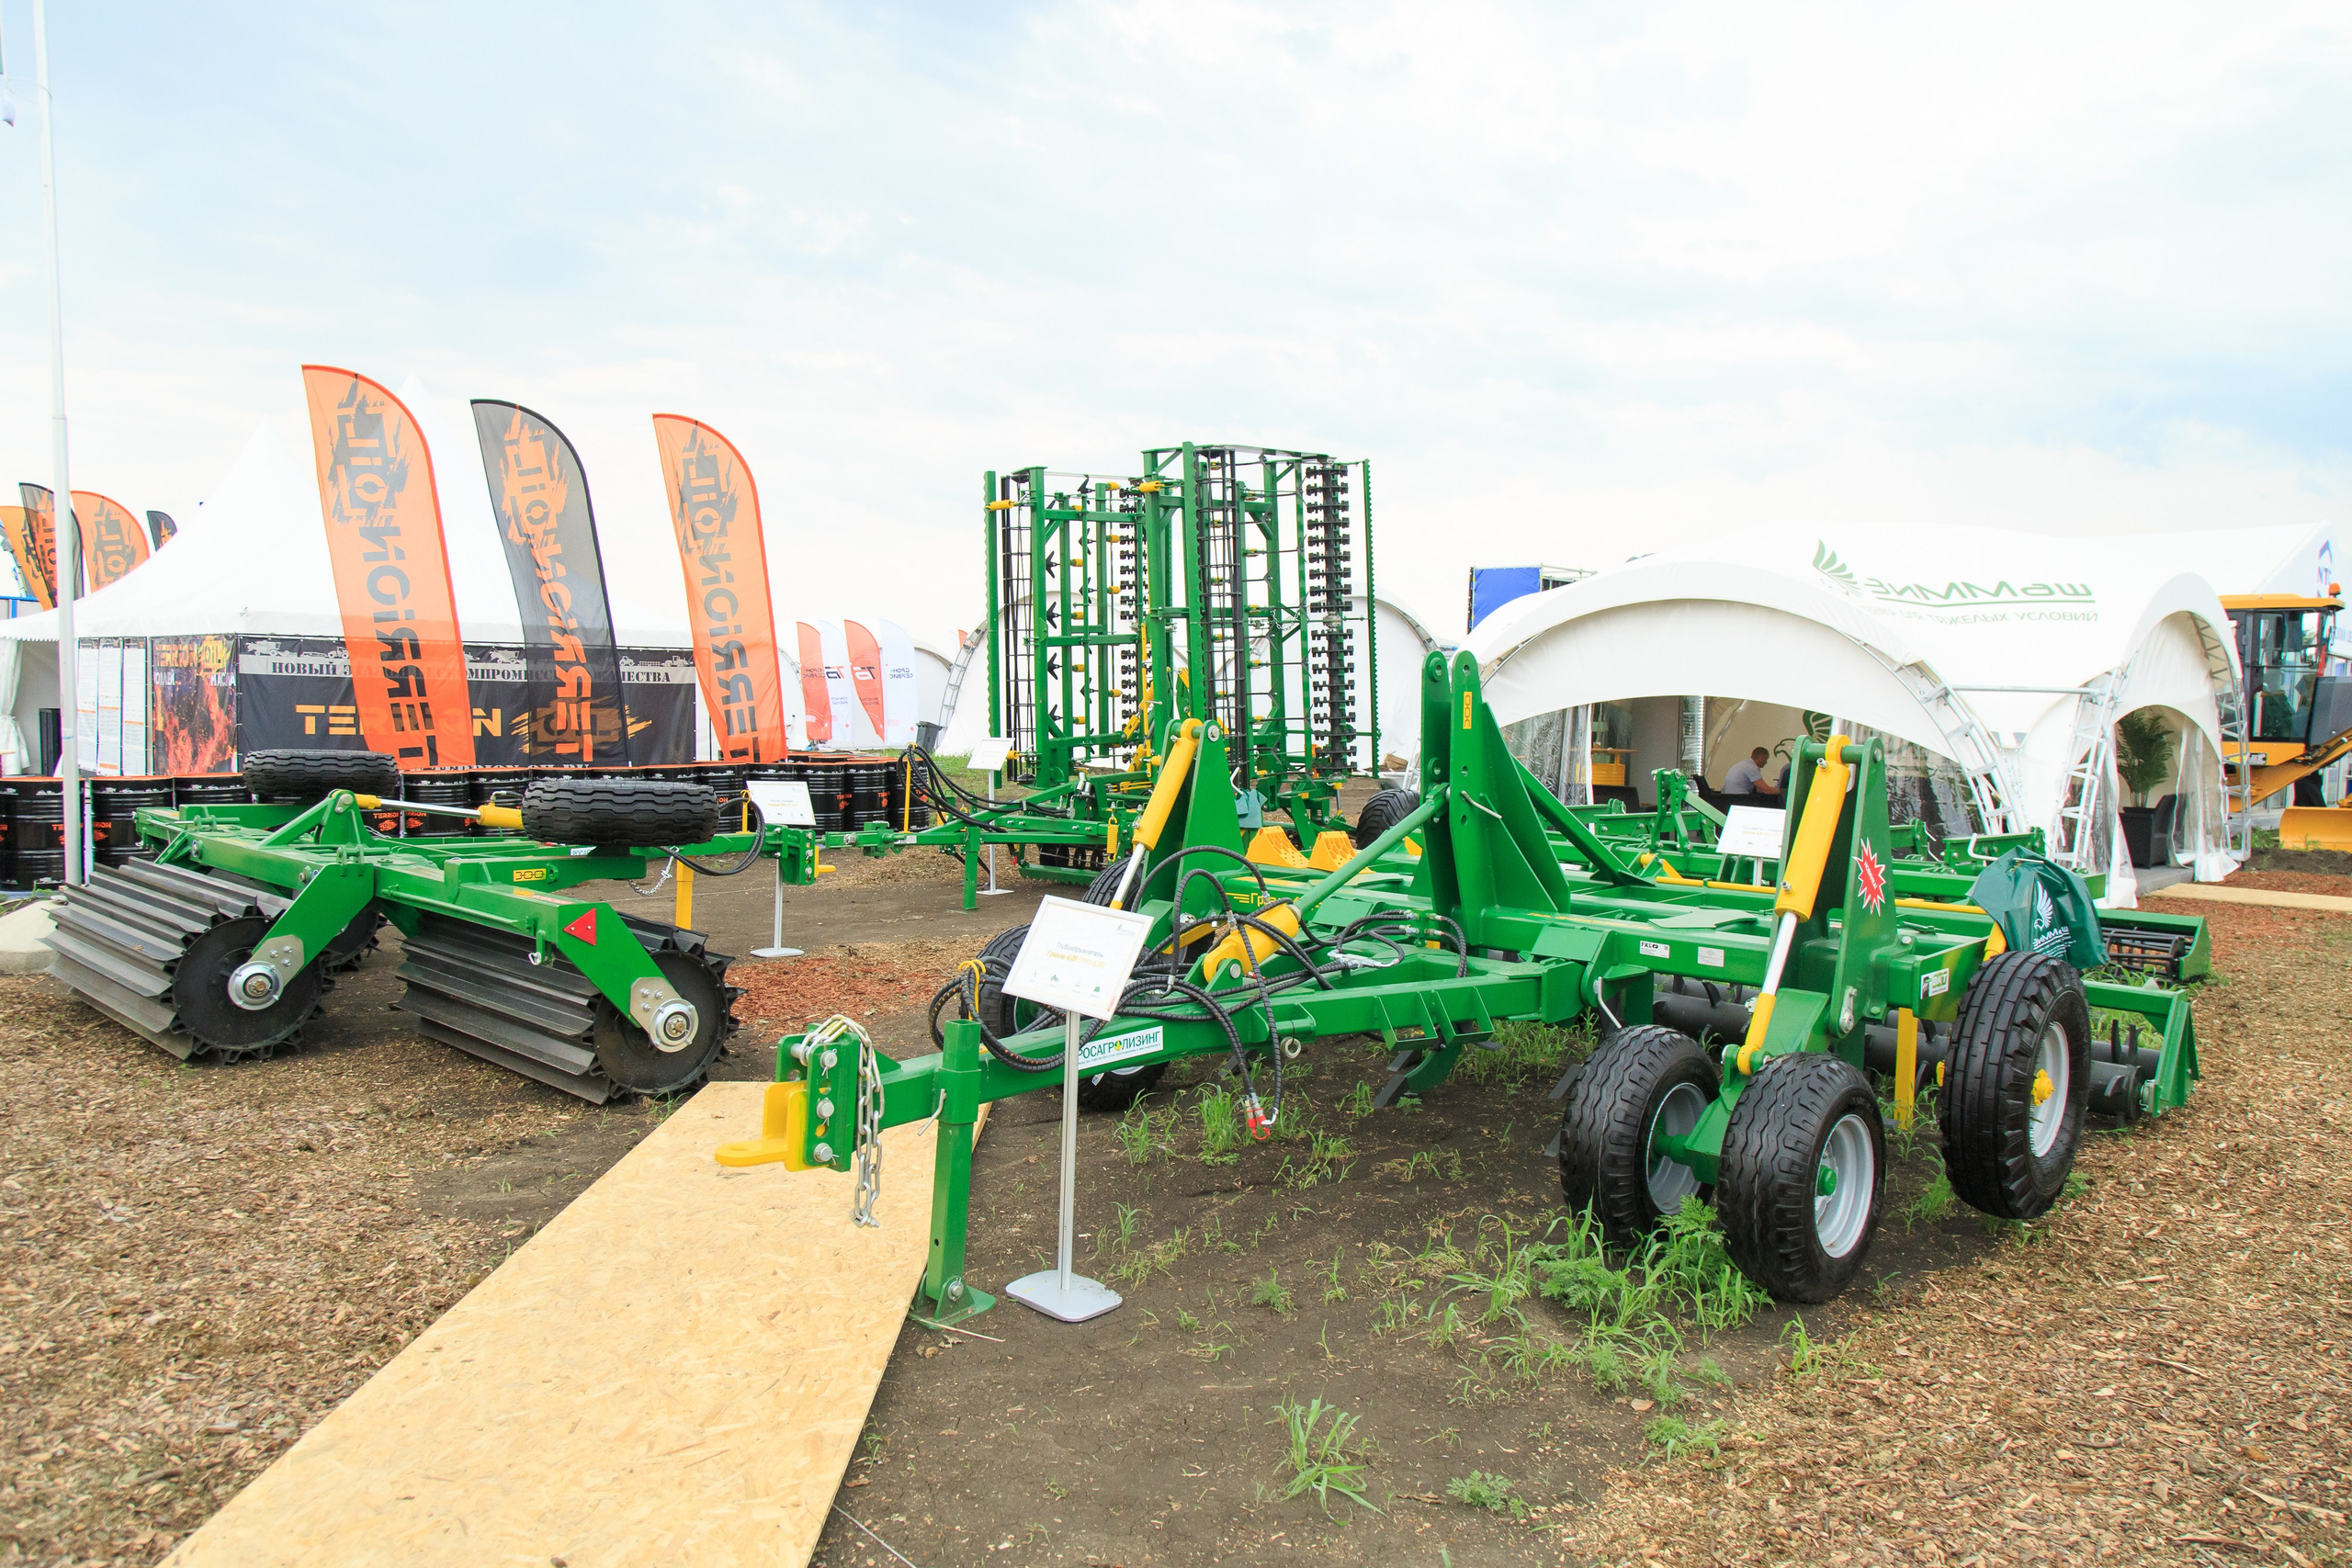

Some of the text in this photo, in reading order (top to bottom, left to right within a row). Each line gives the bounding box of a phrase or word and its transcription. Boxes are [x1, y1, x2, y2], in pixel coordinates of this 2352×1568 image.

[2015, 611, 2099, 623] УСЛОВИЙ
[154, 643, 198, 668] TERRION
[272, 660, 337, 675] НОВЫЙ
